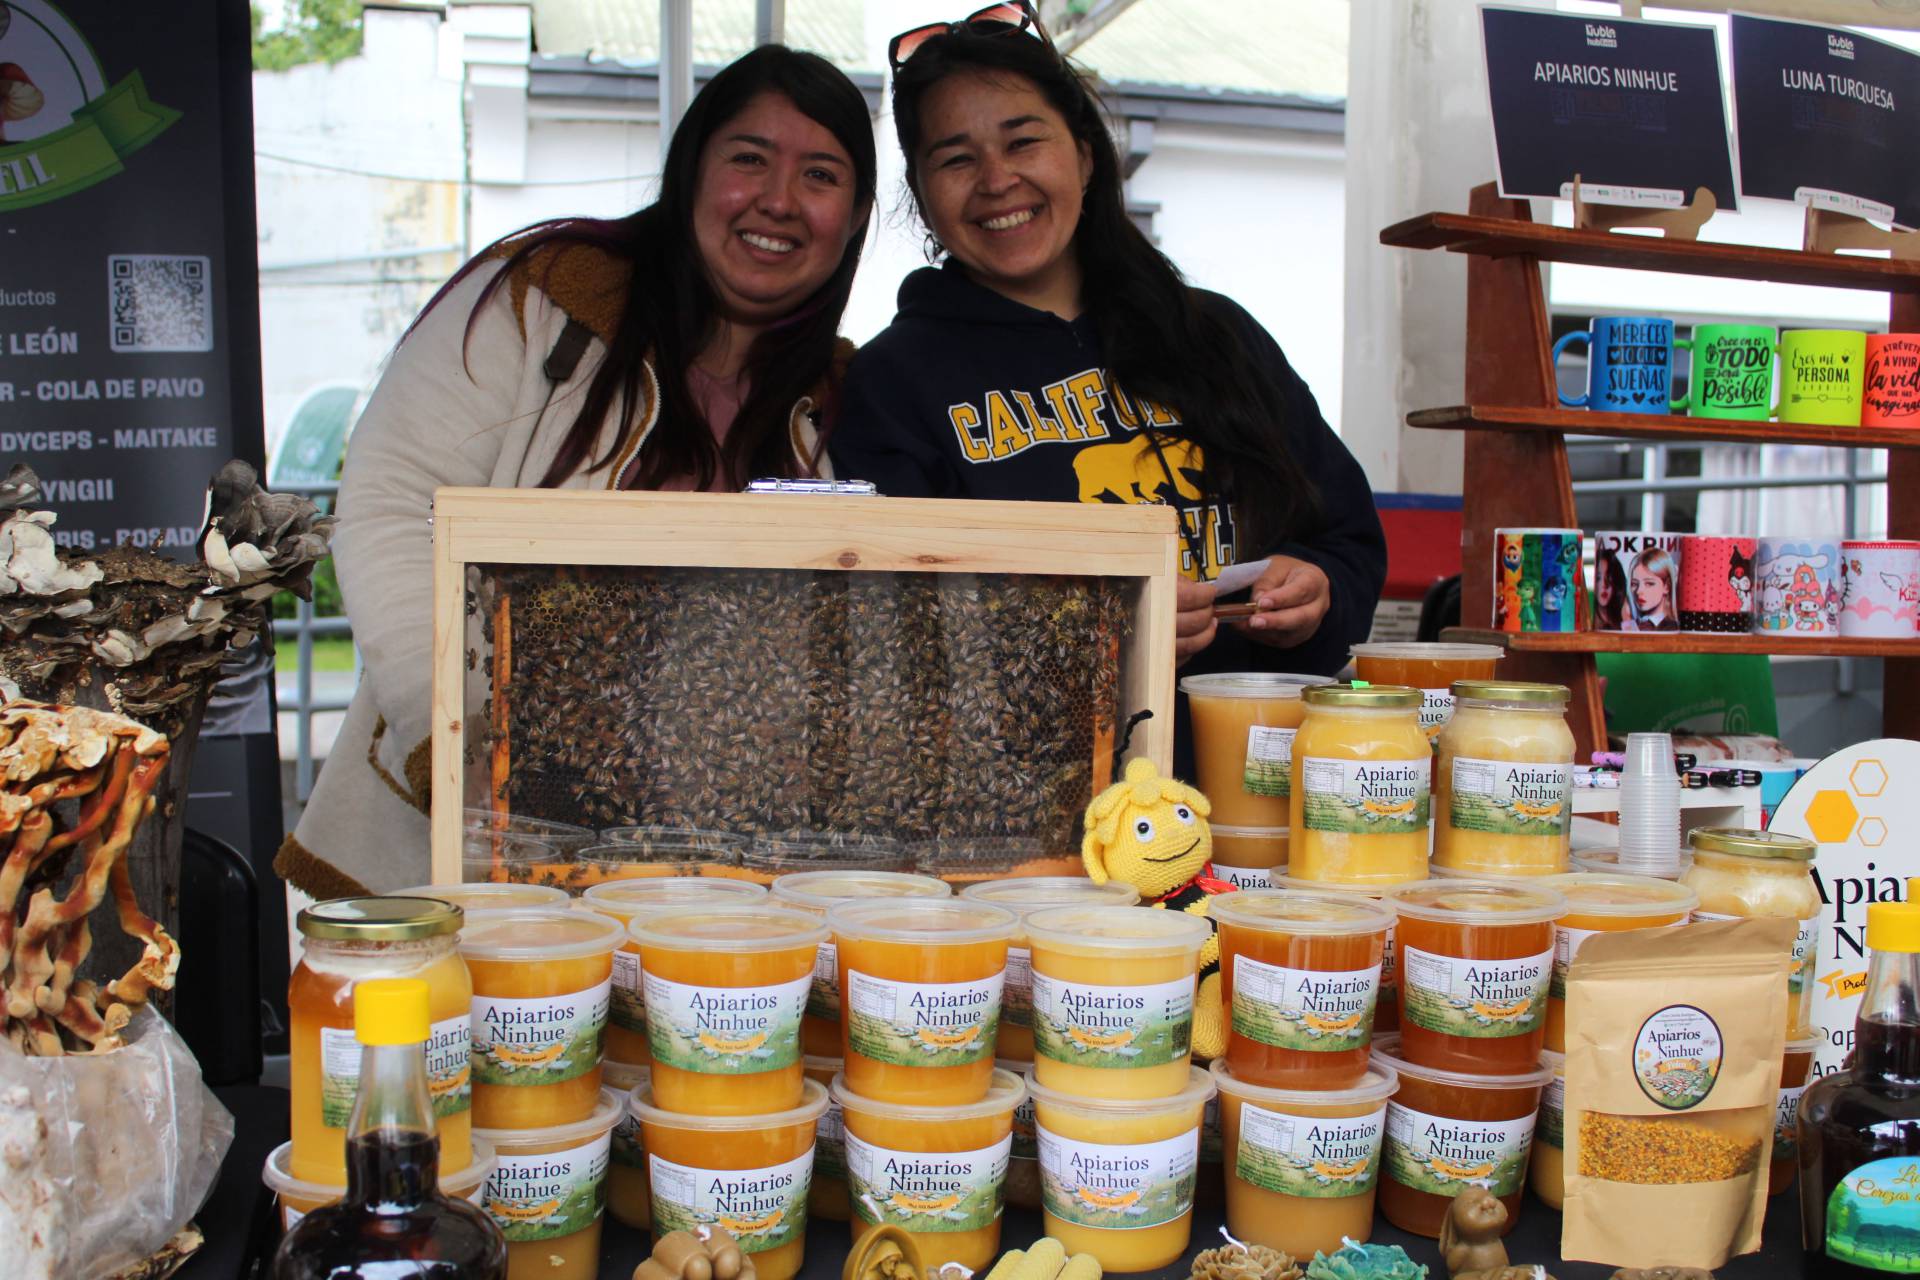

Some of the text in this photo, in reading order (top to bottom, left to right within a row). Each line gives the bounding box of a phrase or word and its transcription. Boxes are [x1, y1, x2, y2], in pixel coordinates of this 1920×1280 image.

[1534, 61, 1679, 92] APIARIOS NINHUE
[1782, 68, 1896, 111] LUNA TURQUESA
[10, 326, 78, 354] LEÓN
[1609, 323, 1667, 344] MERECES
[1718, 347, 1770, 369] TODO
[1608, 364, 1665, 392] SUEÑAS
[1796, 367, 1850, 383] PERSONA
[37, 381, 99, 401] COLA
[105, 380, 136, 400] DE
[142, 378, 205, 398] PAVO
[114, 428, 217, 448] MAITAKE
[1355, 766, 1419, 786] Apiarios
[1361, 783, 1416, 798] Ninhue
[1511, 785, 1563, 800] Ninhue
[1464, 964, 1539, 986] Apiarios
[1297, 977, 1370, 999] Apiarios
[1471, 984, 1532, 1000] Ninhue
[689, 991, 777, 1015] Apiarios
[910, 988, 989, 1013] Apiarios
[1061, 988, 1144, 1012] Apiarios
[1302, 996, 1363, 1012] Ninhue
[484, 1004, 575, 1029] Apiarios
[696, 1012, 768, 1031] Ninhue
[915, 1010, 981, 1026] Ninhue
[1066, 1008, 1134, 1028] Ninhue
[490, 1025, 565, 1044] Ninhue
[1648, 1027, 1701, 1048] Apiarios
[1658, 1045, 1704, 1060] Ninhue
[1306, 1123, 1377, 1146] Apiarios
[1424, 1122, 1505, 1144] Apiarios
[1312, 1142, 1370, 1159] Ninhue
[1429, 1140, 1496, 1161] Ninhue
[488, 1161, 571, 1184] piarios
[884, 1157, 972, 1179] Apiarios
[1070, 1151, 1150, 1173] Apiarios
[709, 1171, 792, 1200] Apiarios
[889, 1176, 961, 1191] Ninhue
[1075, 1170, 1140, 1189] Ninhue
[486, 1181, 561, 1200] Ninhue
[715, 1194, 784, 1213] Ninhue
